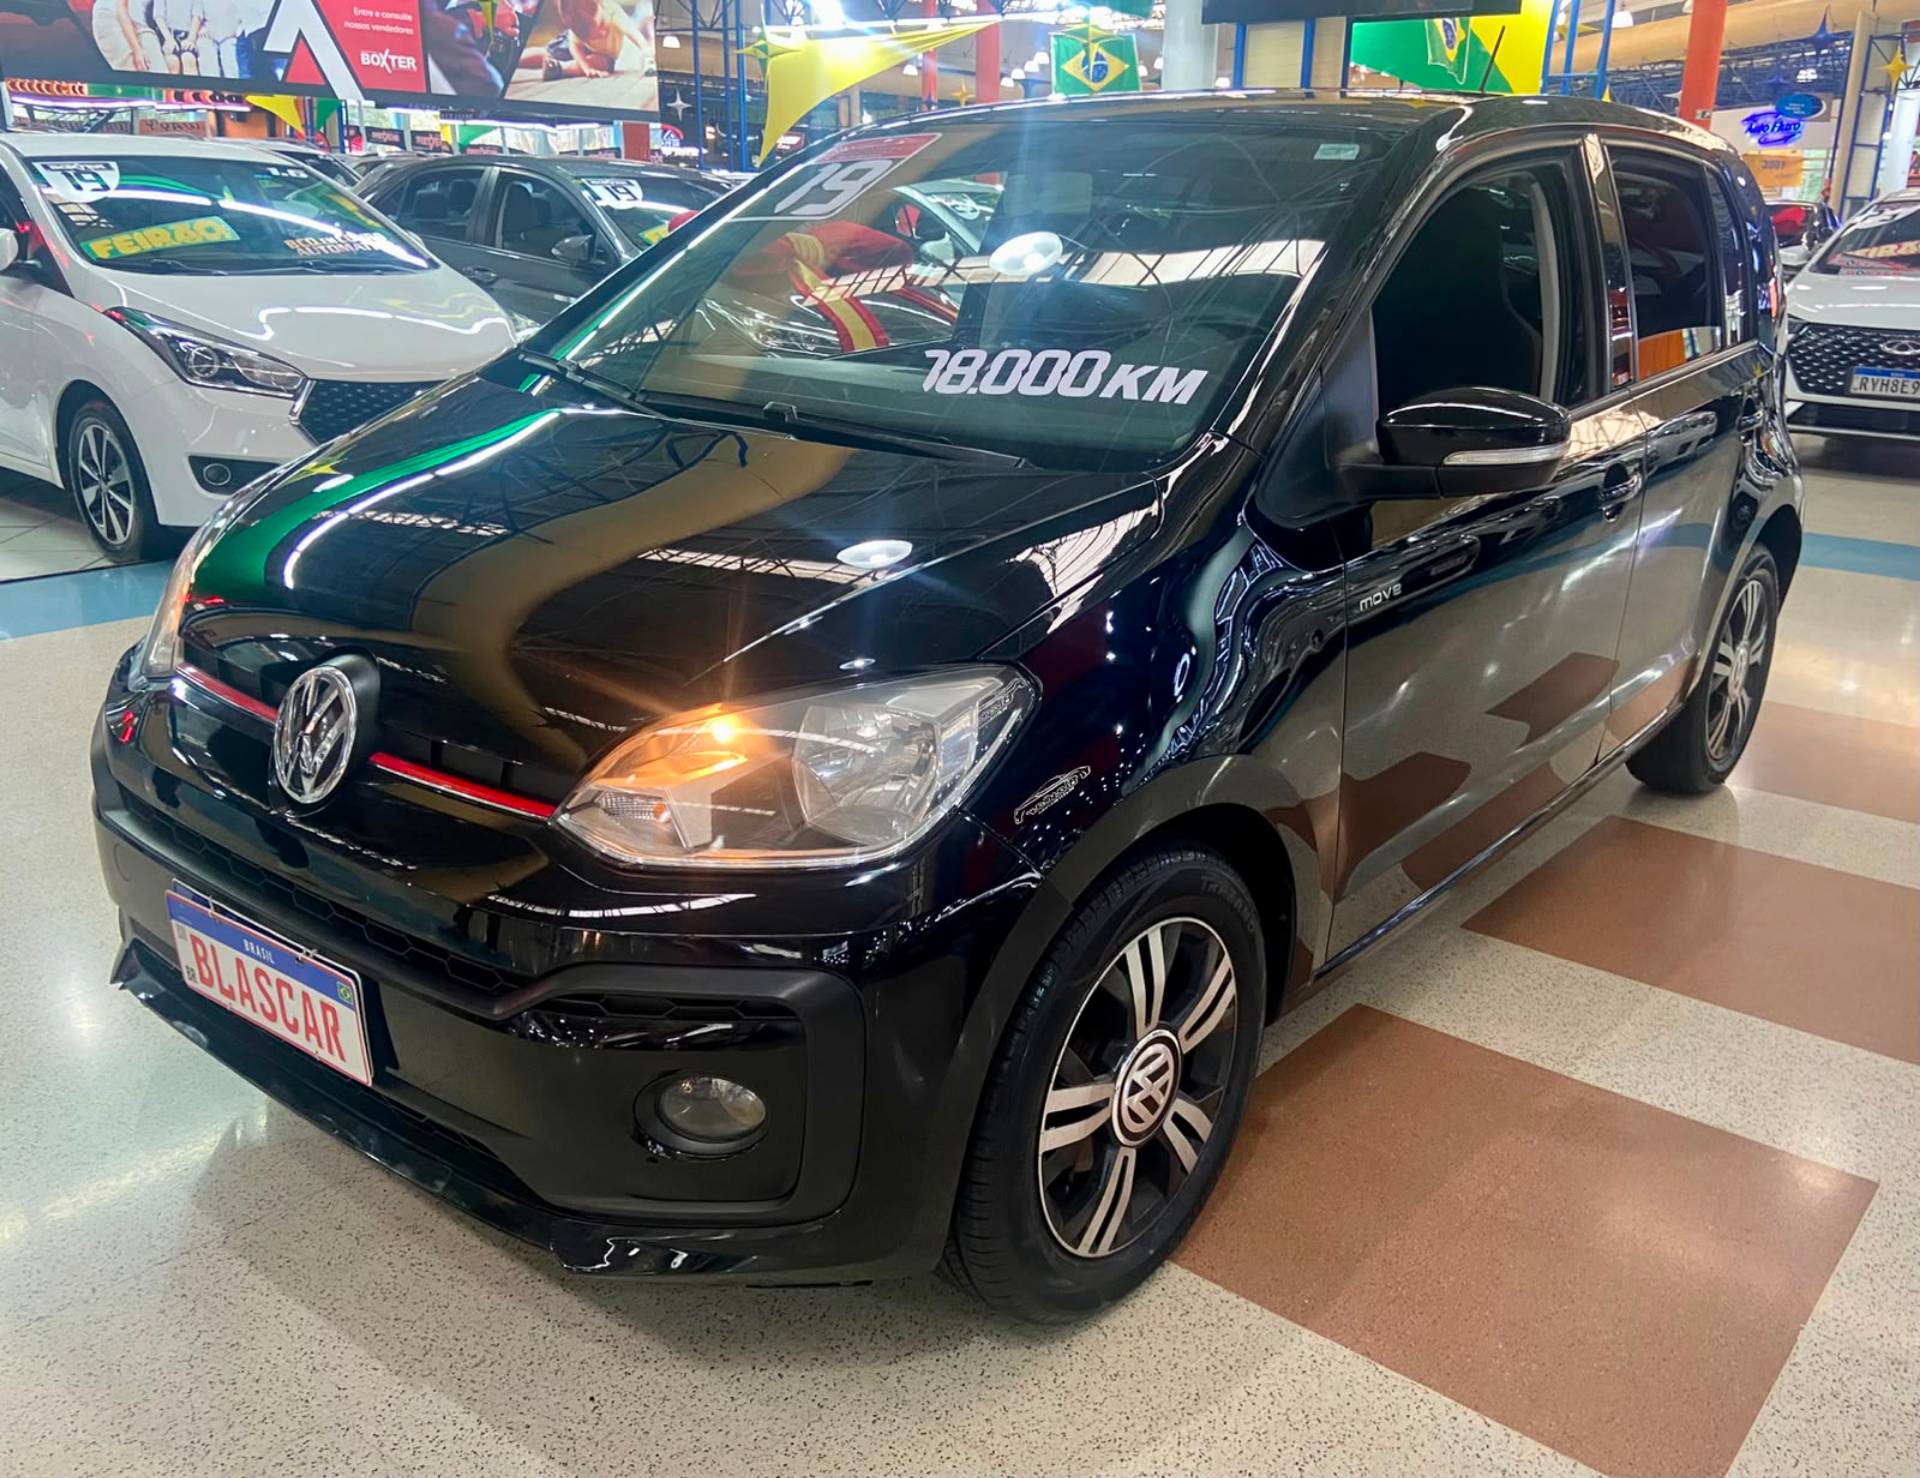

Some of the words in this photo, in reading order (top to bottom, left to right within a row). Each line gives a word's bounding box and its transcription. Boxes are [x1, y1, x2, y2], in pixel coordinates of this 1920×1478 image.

[353, 6, 374, 17] Entre
[381, 11, 413, 22] consulte
[343, 21, 371, 31] nossos
[371, 24, 414, 35] vendedores
[360, 48, 417, 75] BOXTER
[60, 170, 111, 192] 19
[604, 185, 639, 201] 19
[774, 159, 894, 216] 19
[1099, 363, 1209, 405] KM
[1359, 582, 1403, 613] move
[242, 938, 276, 966] BRASIL
[189, 933, 347, 1063] BLASCAR
